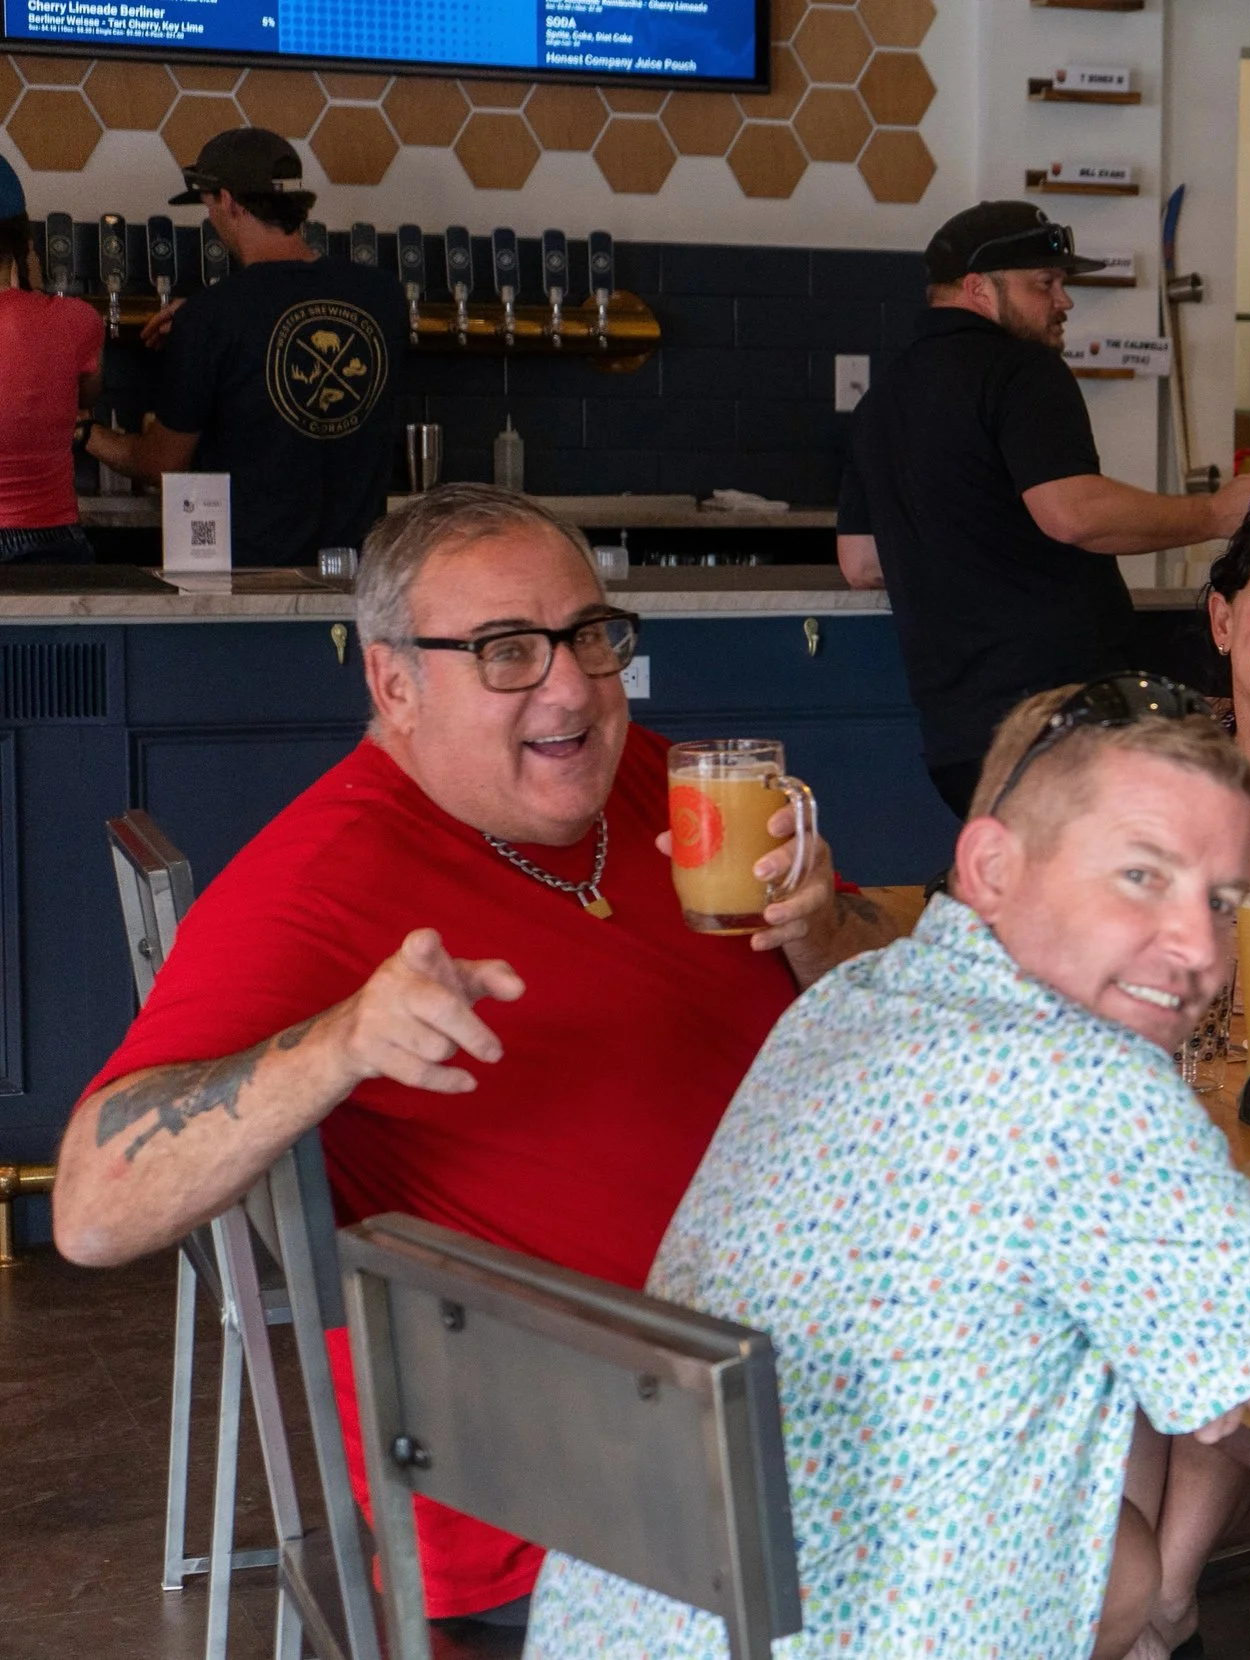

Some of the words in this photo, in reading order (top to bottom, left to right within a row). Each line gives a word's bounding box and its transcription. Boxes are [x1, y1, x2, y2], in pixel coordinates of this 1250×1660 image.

[28, 0, 66, 15] Cherry
[68, 1, 118, 15] Limeade
[119, 4, 165, 19] Berliner
[28, 13, 65, 25] Berliner
[107, 17, 127, 29] Tart
[162, 20, 180, 33] Key
[181, 21, 205, 34] Lime
[545, 15, 577, 29] SODA
[545, 51, 584, 66] Honest
[584, 53, 634, 70] Company
[635, 56, 663, 70] Juice
[663, 57, 697, 72] Pouch
